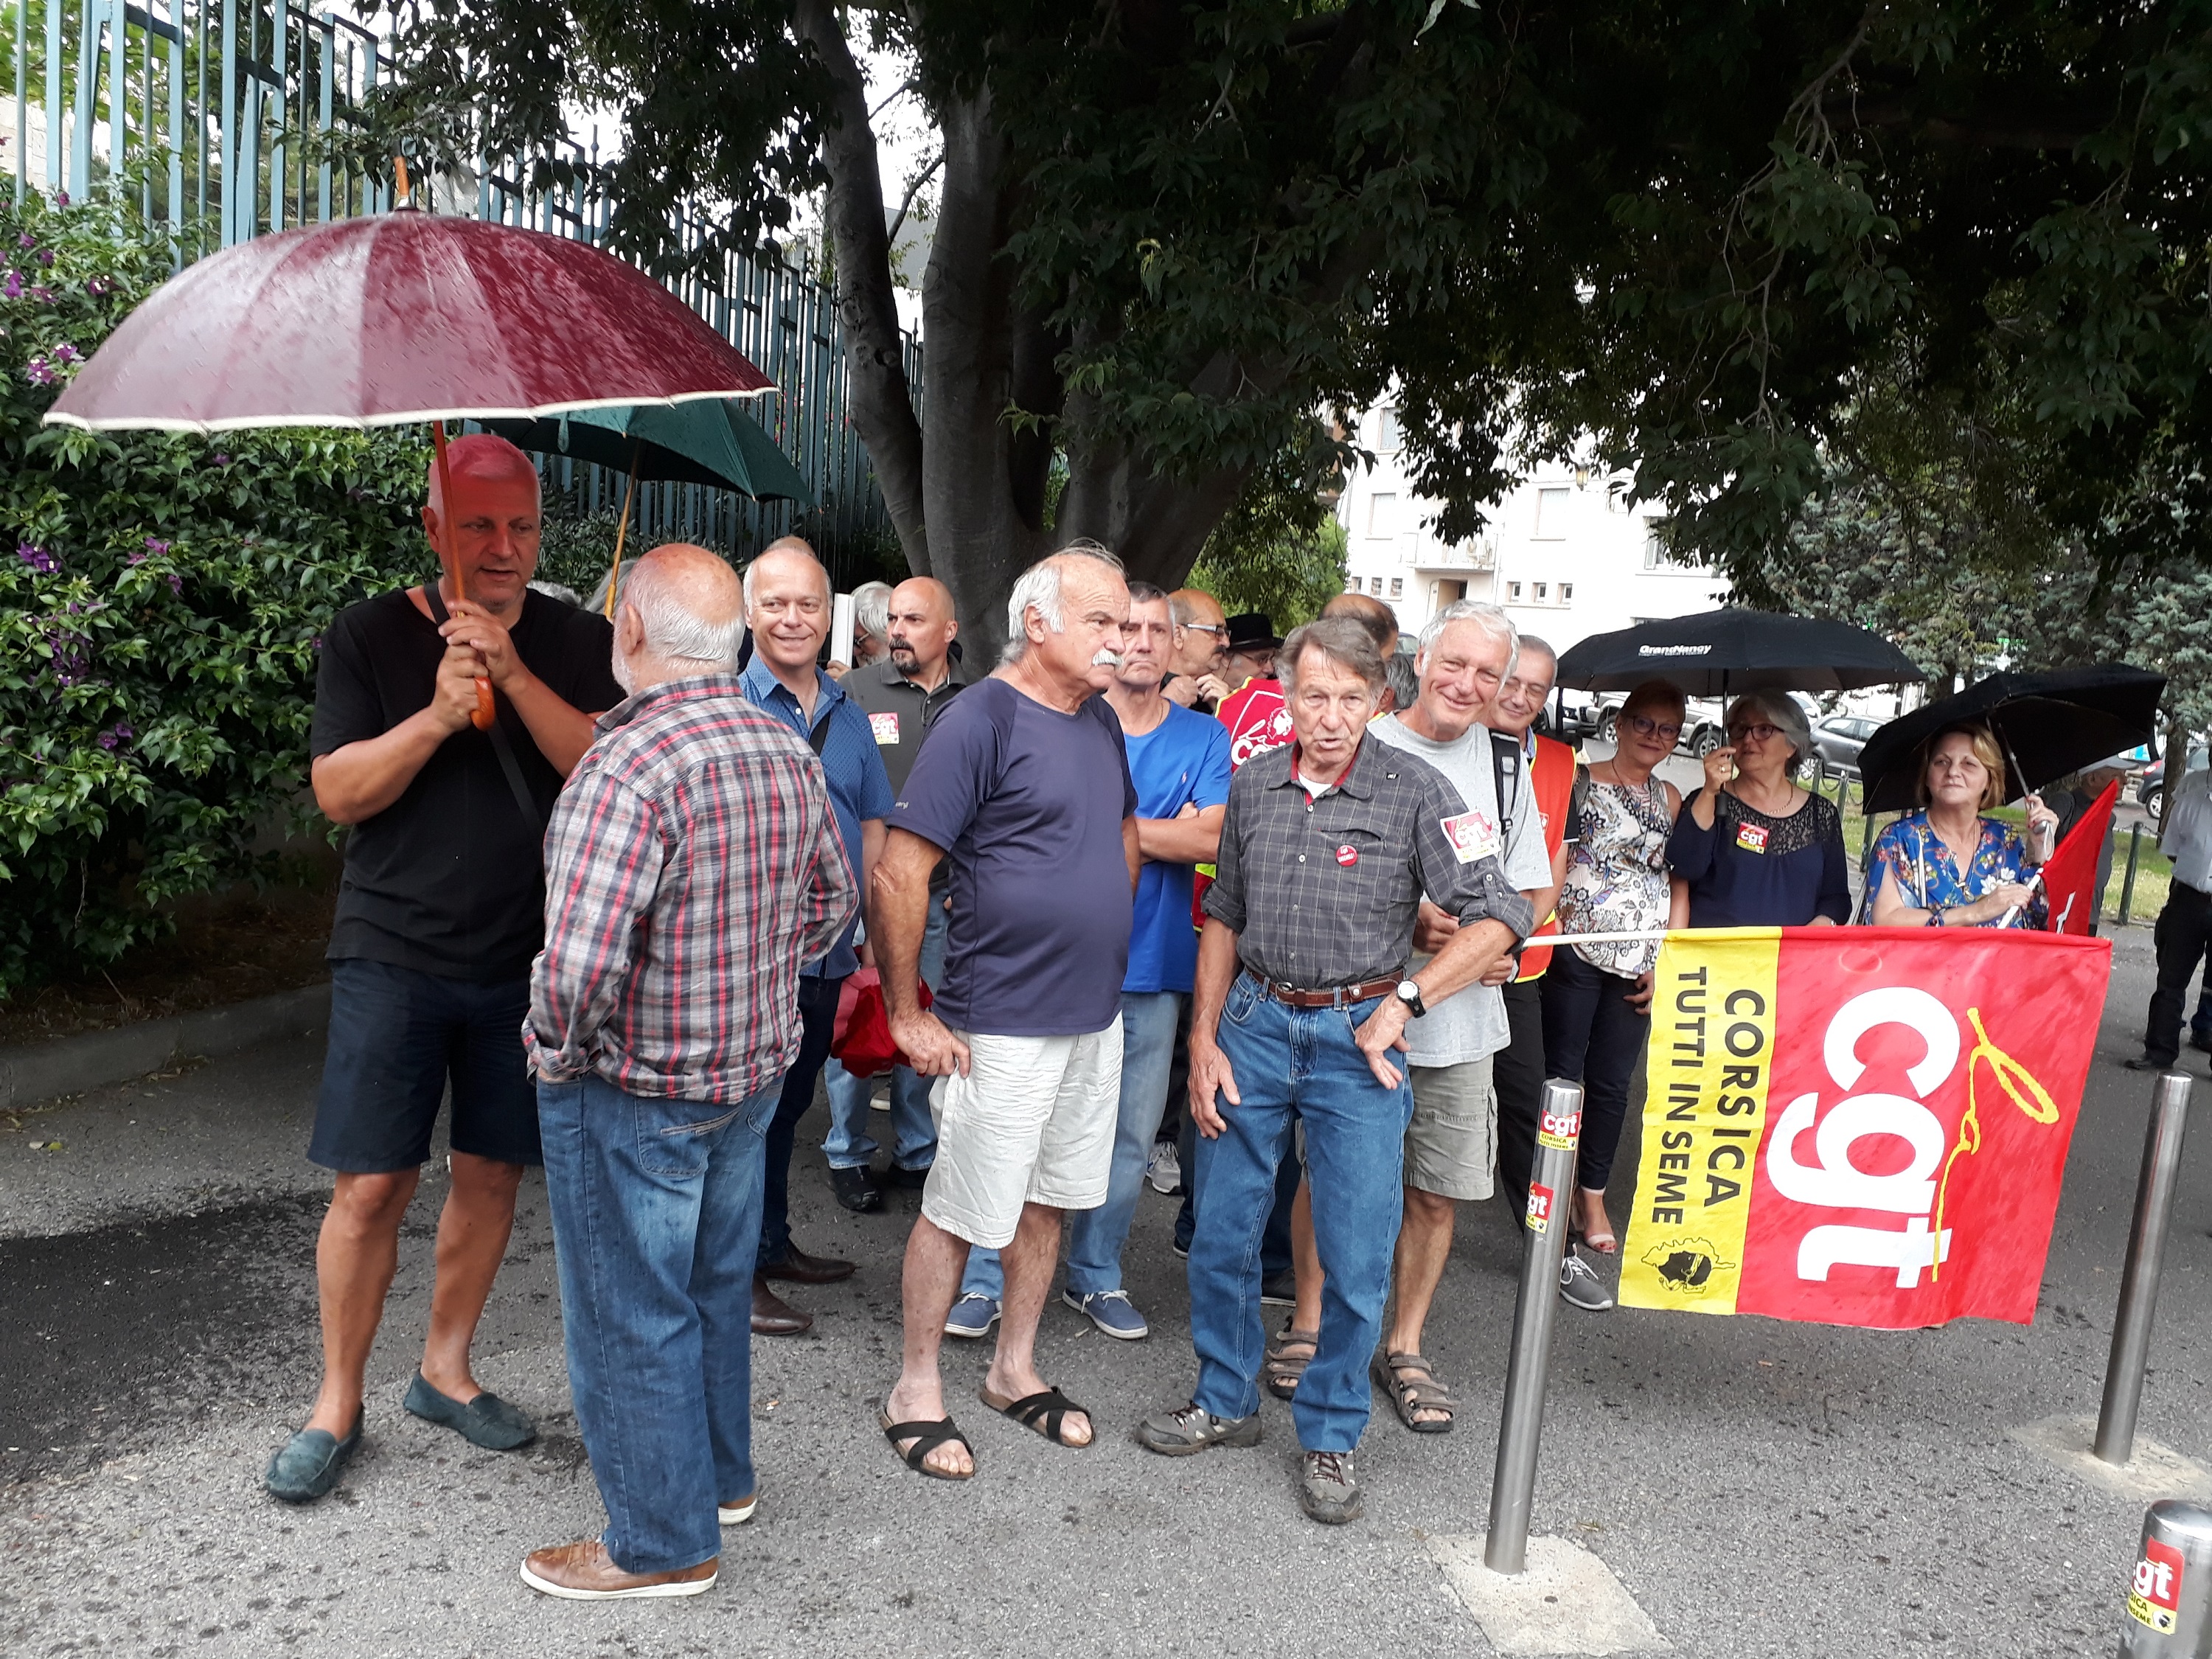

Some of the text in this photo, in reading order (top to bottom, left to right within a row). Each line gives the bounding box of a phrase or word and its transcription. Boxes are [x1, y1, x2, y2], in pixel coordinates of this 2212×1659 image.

[1741, 830, 1764, 846] cgt
[1671, 966, 1707, 1068] TUTTI
[1703, 989, 1766, 1208] CORSICA
[1541, 1133, 1567, 1144] CORSICA
[1543, 1114, 1577, 1137] cgt
[1766, 987, 1961, 1289] cgt
[1528, 1194, 1548, 1216] gt
[2133, 1559, 2173, 1601] gt
